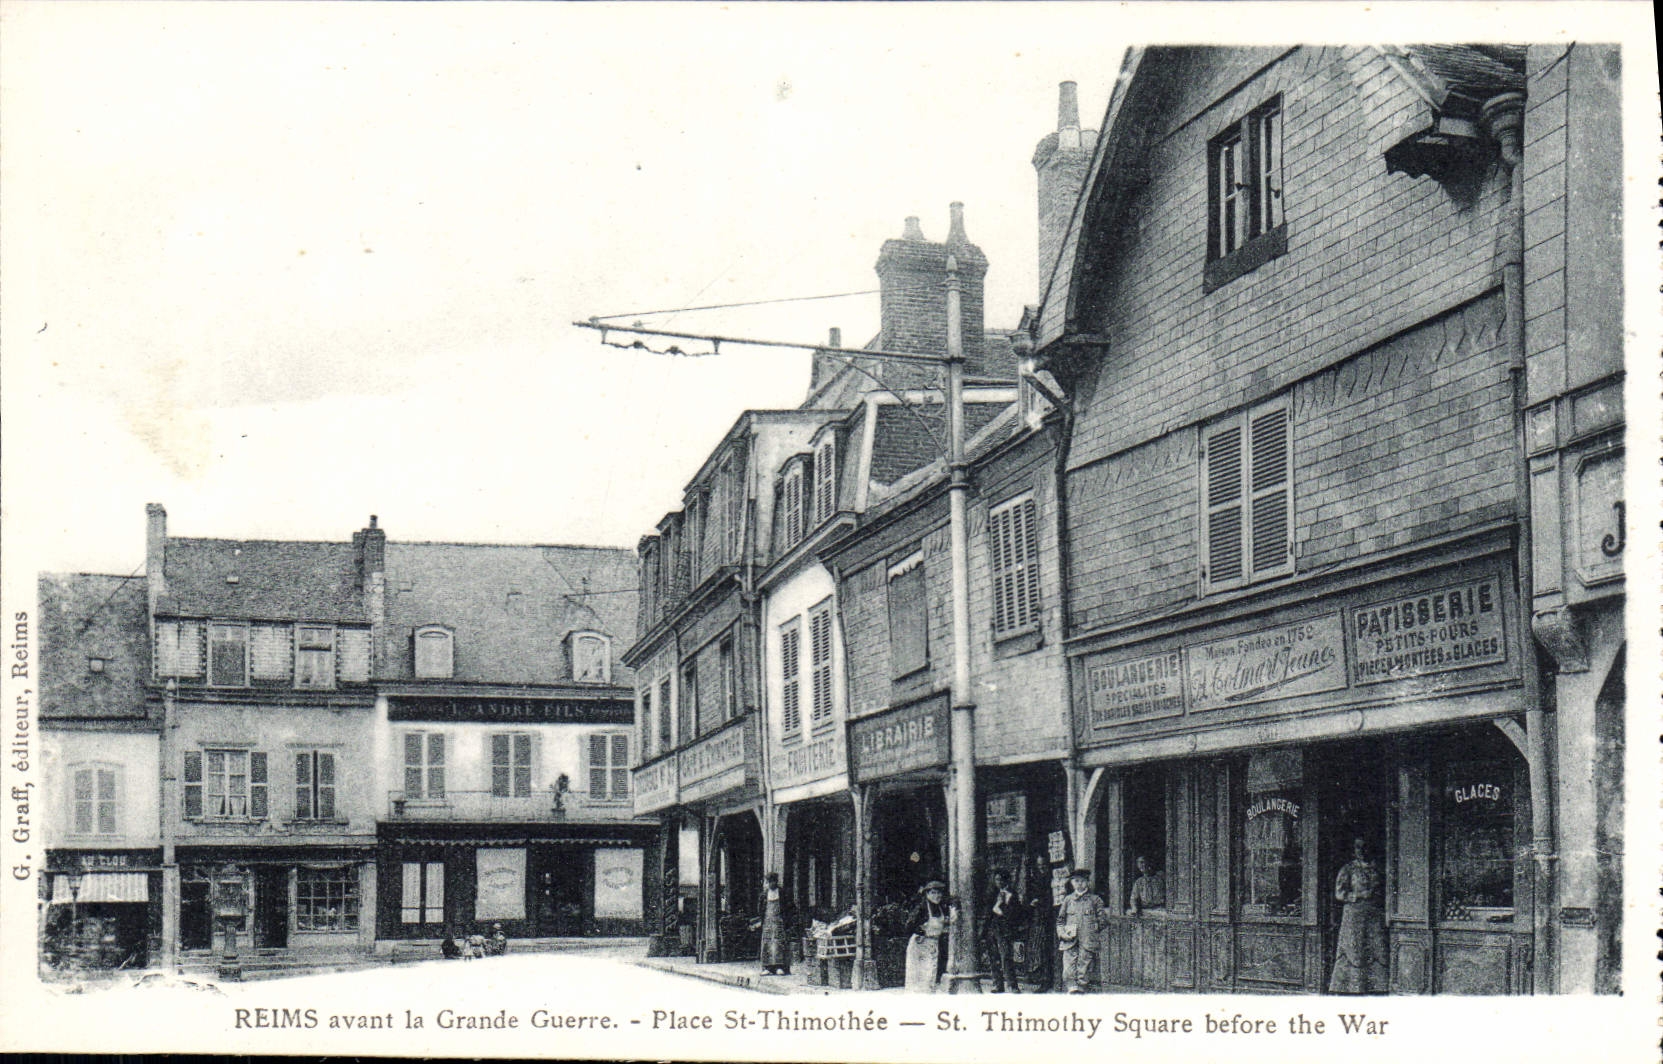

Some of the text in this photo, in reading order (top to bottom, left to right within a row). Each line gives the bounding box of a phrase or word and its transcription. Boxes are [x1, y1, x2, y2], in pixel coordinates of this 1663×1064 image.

[1356, 583, 1494, 640] PATISSERIE
[1453, 636, 1499, 662] GLACES
[1091, 652, 1179, 693] BOULANGERIE
[543, 704, 585, 718] FILS
[861, 715, 935, 754] LIBRAIRIE
[787, 737, 836, 778] FRUITERIE
[1454, 783, 1501, 803] GLACES
[1246, 798, 1301, 821] BOULANGERIE
